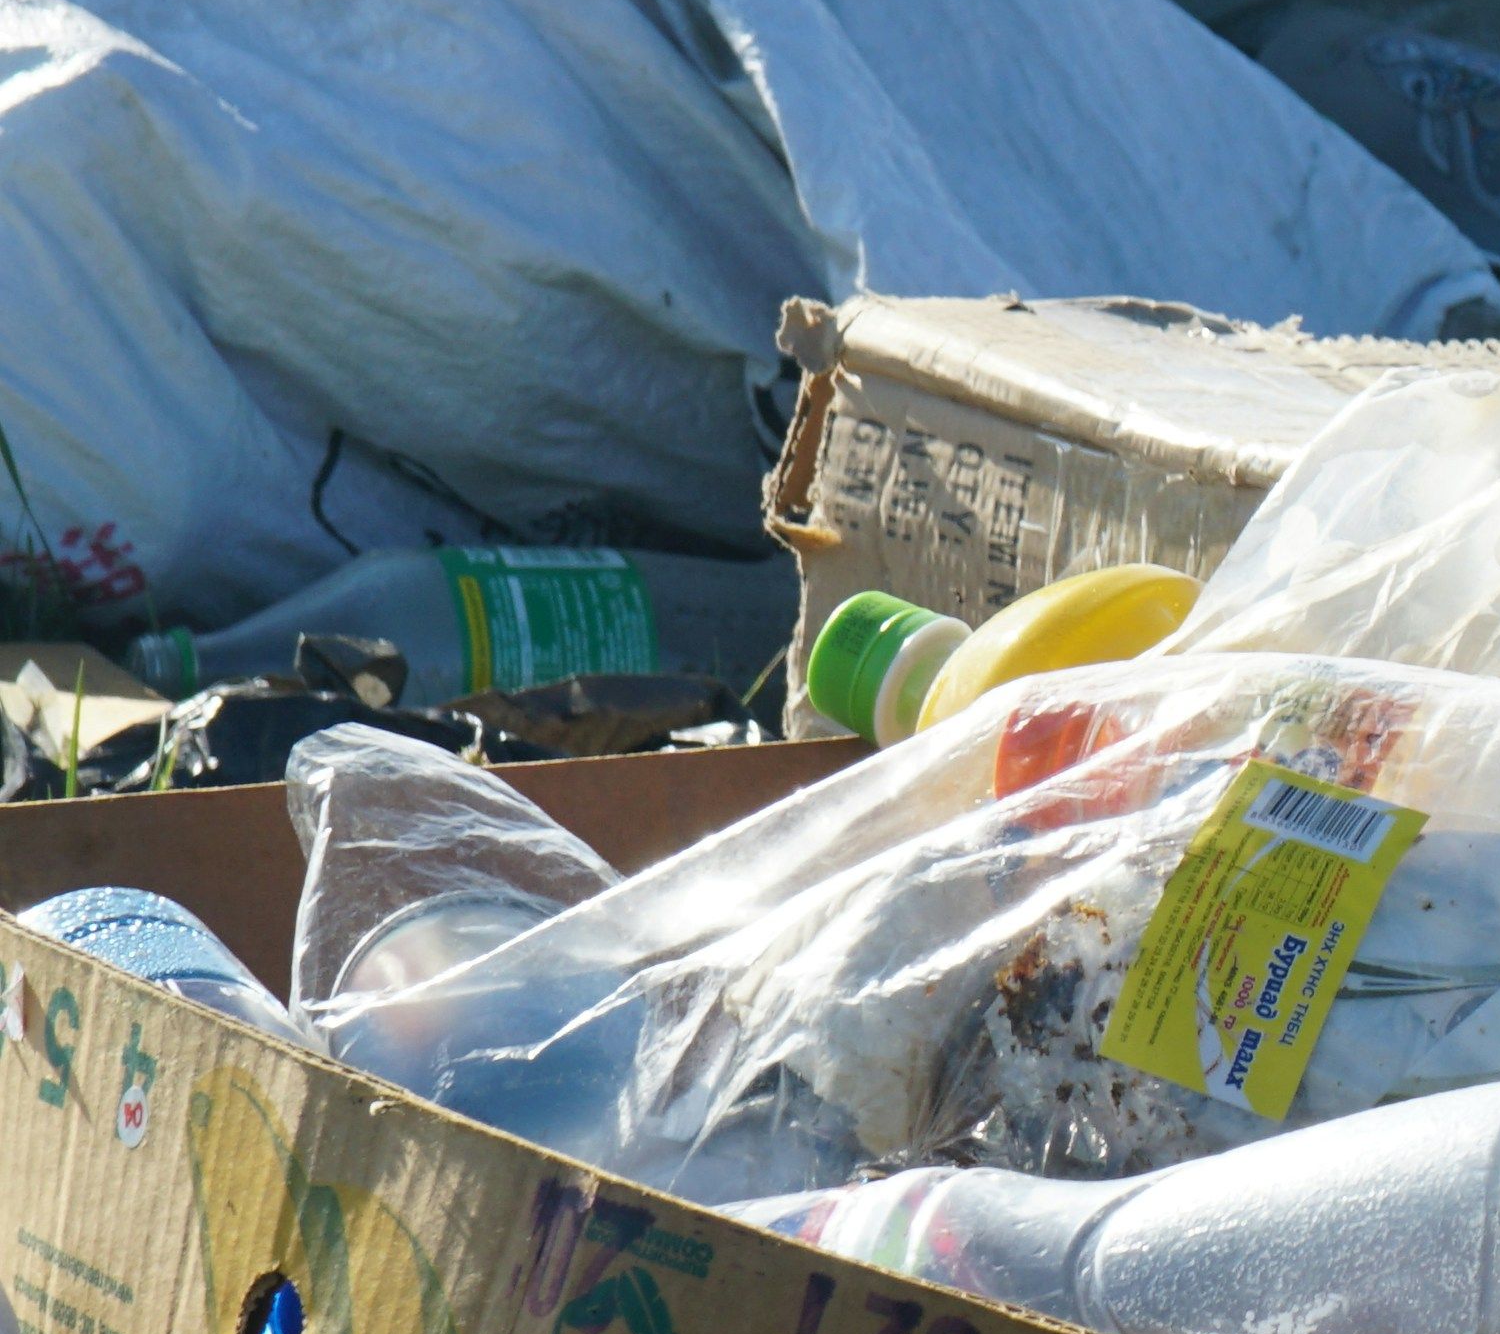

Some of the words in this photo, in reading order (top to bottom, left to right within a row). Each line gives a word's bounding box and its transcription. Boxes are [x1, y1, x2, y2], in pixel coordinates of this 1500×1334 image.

[1320, 920, 1345, 953] ЭНХ
[1231, 973, 1257, 1010] 1000
[1246, 929, 1310, 1022] Буриад
[1300, 956, 1330, 1000] ХҮНС
[1220, 1013, 1238, 1031] гр
